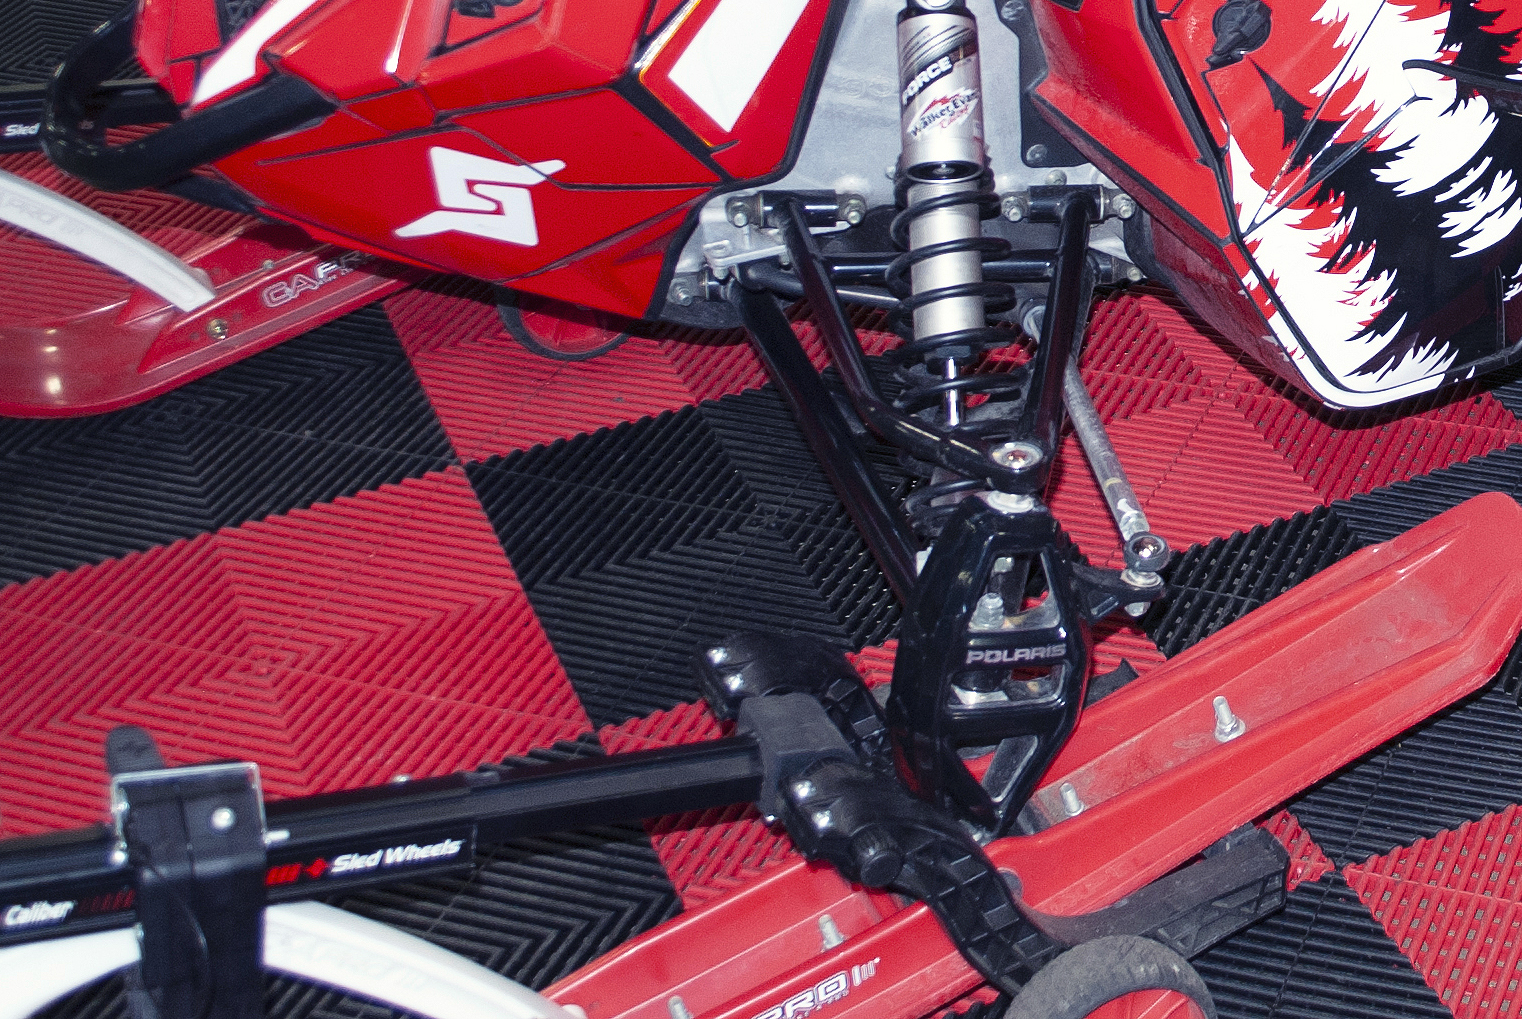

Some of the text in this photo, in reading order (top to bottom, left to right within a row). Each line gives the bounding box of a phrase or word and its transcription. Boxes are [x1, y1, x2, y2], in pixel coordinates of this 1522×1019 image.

[966, 644, 1067, 665] POLARIS
[330, 837, 463, 873] Sled Wheels
[4, 899, 76, 926] Caliber
